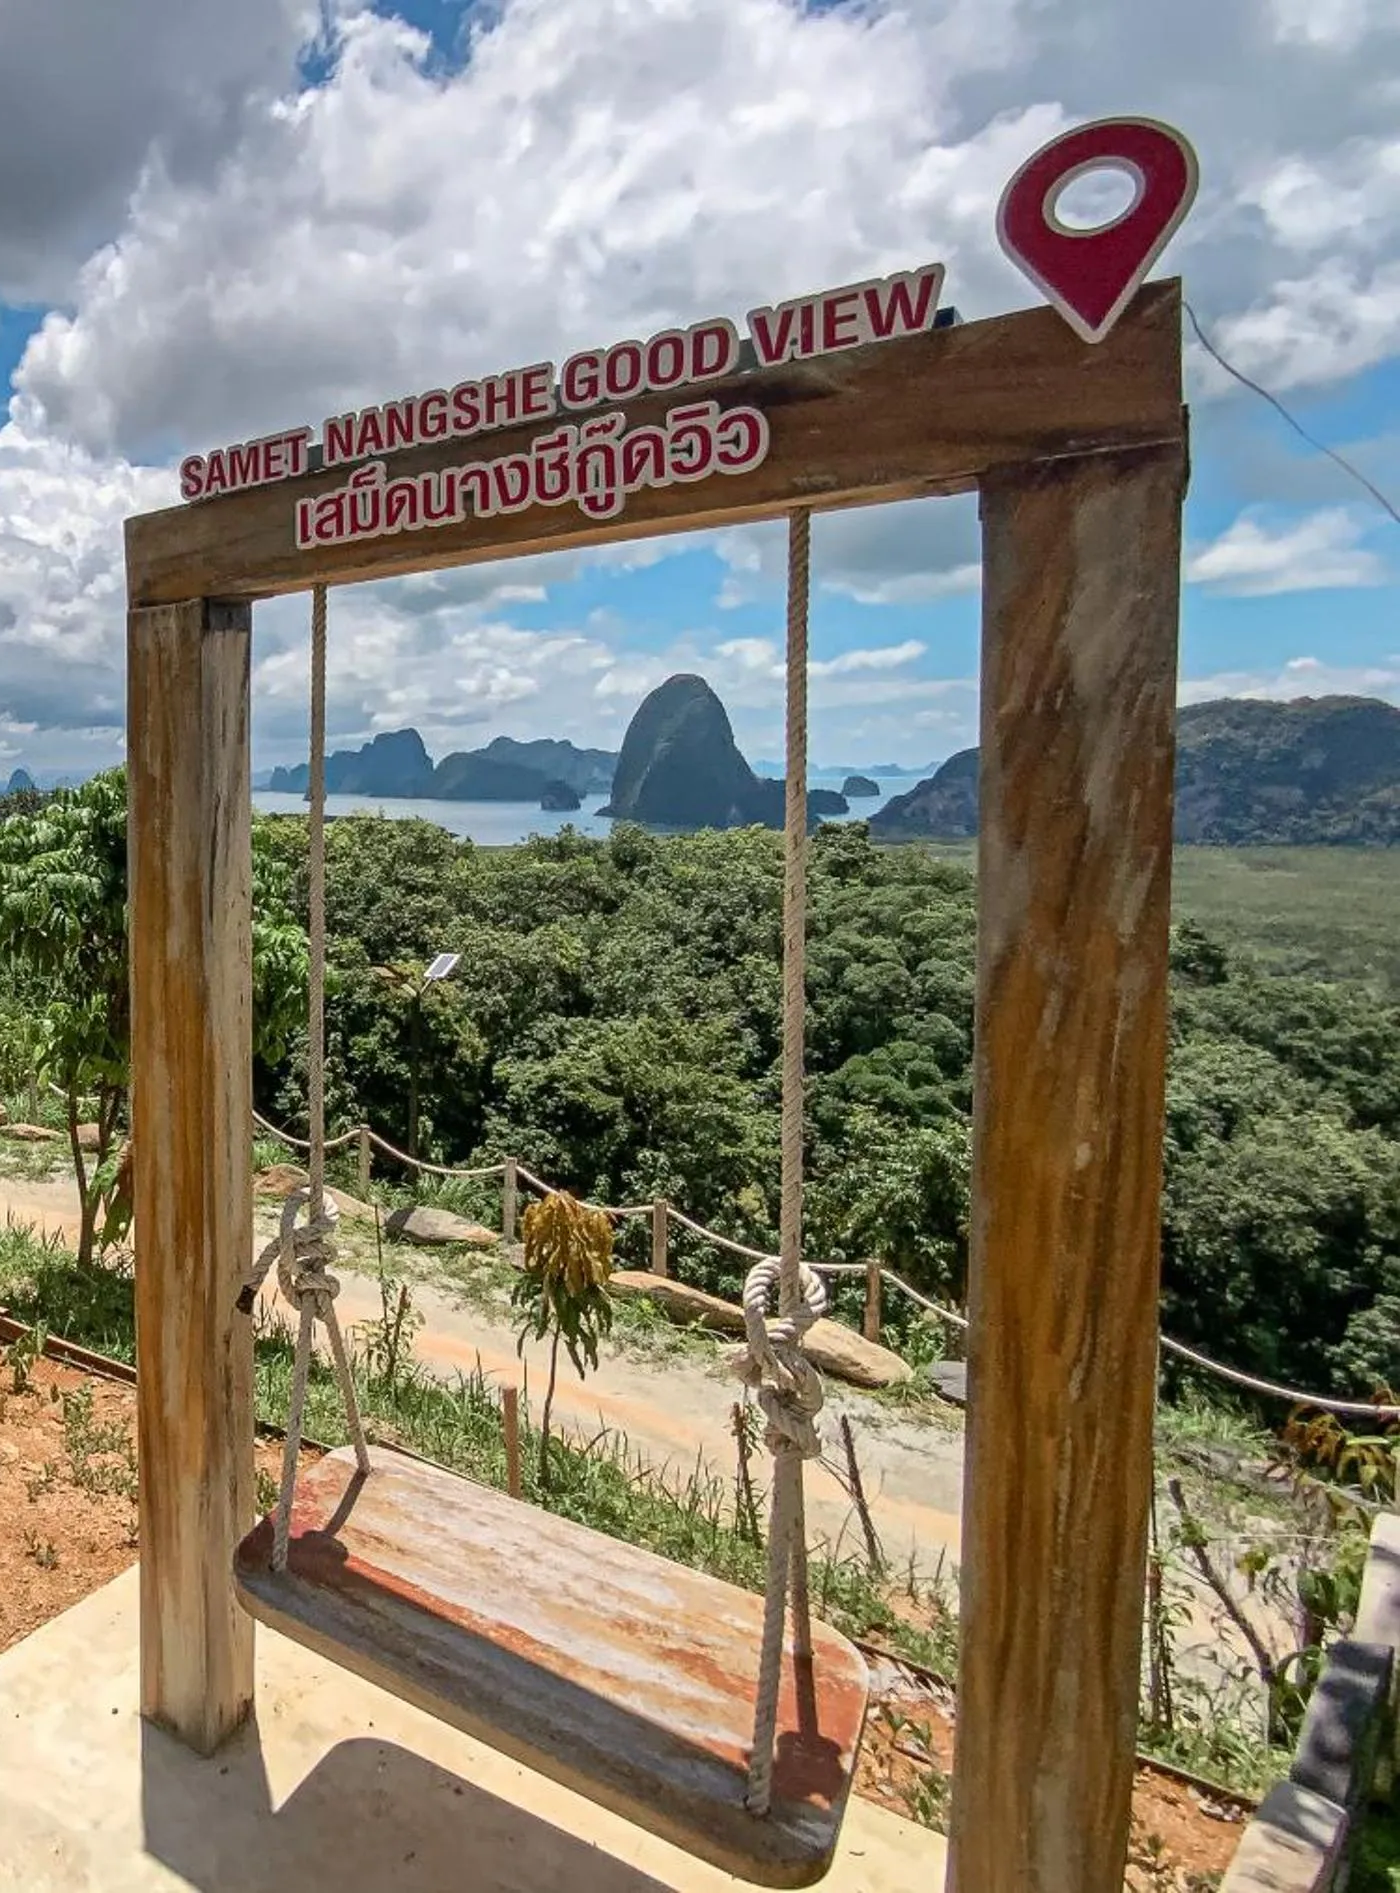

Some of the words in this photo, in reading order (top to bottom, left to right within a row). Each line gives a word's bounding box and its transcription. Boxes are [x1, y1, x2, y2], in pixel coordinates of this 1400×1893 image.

[179, 431, 310, 499] SAMET
[326, 367, 552, 463] NANGSHE
[561, 325, 733, 406] GOOD
[751, 271, 937, 366] VIEW
[298, 405, 763, 545] เสม็ดนางชีกู๊ดวิว
